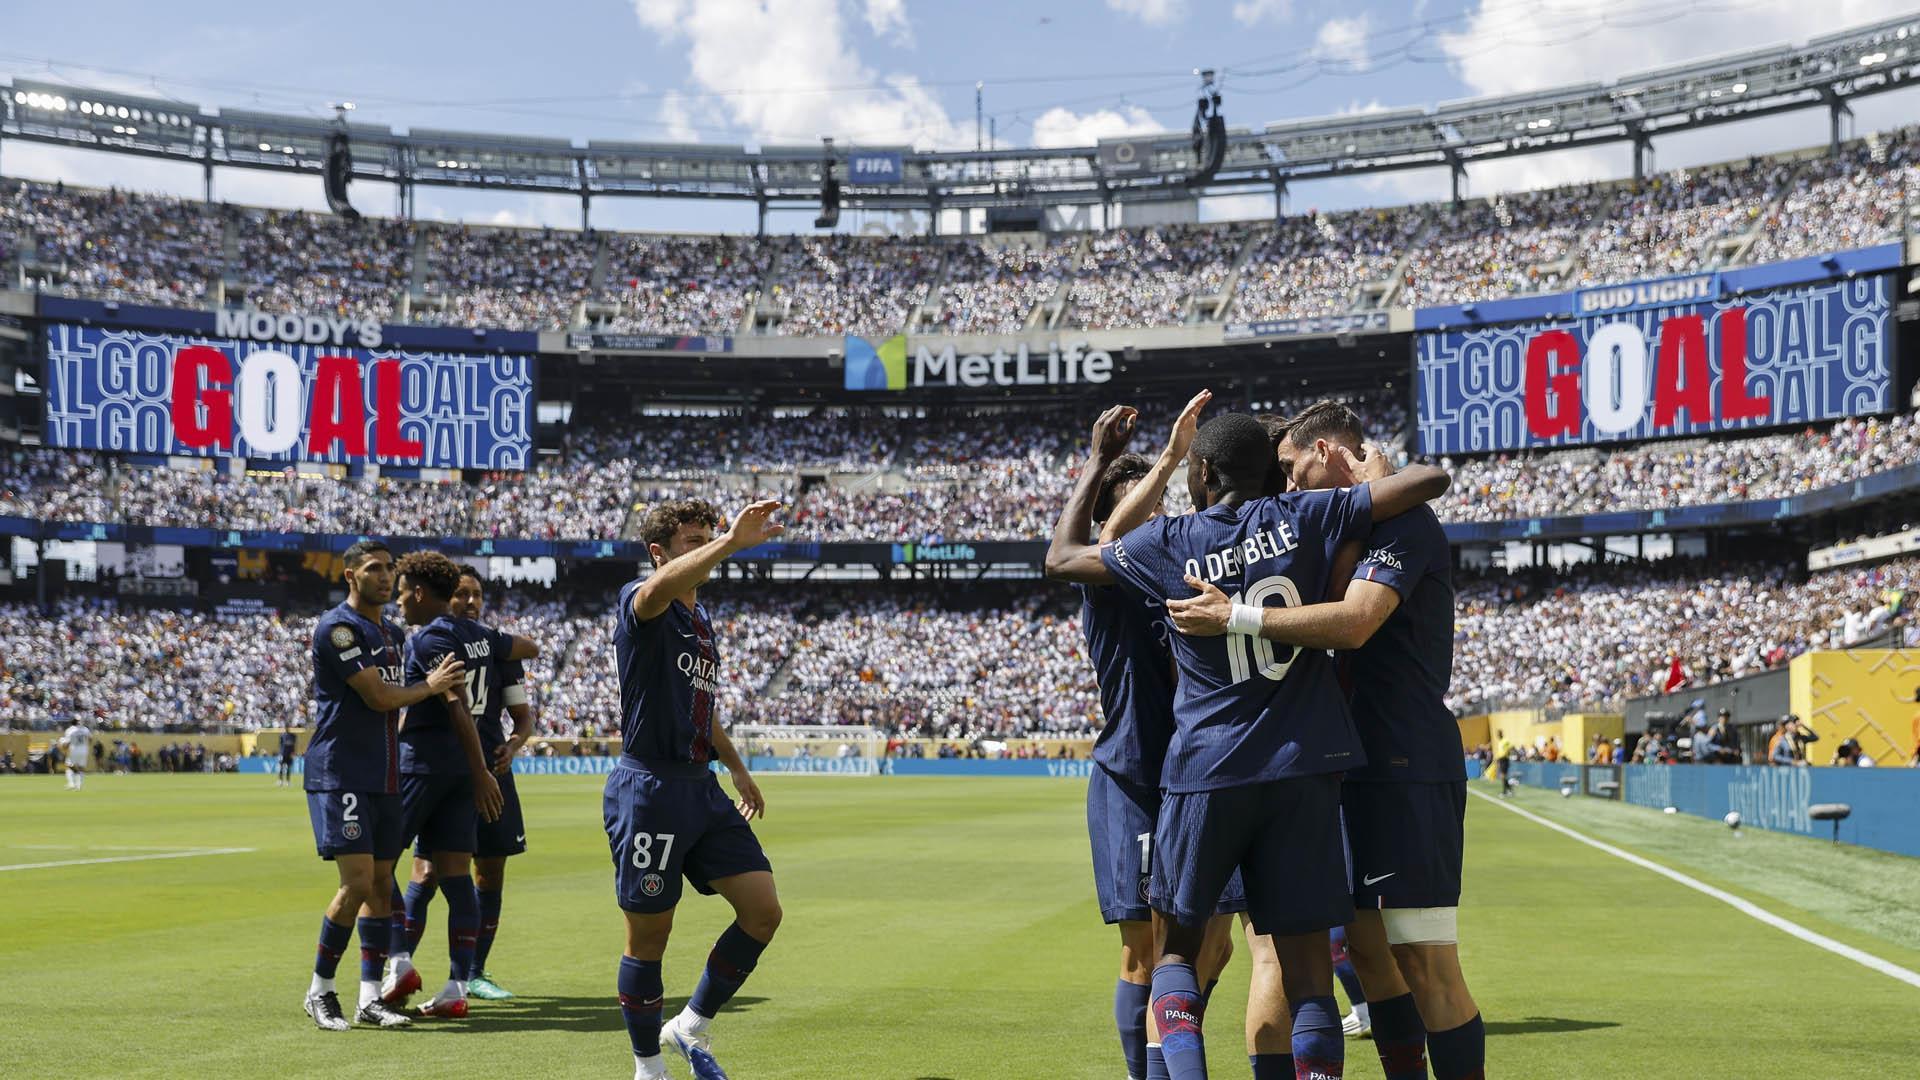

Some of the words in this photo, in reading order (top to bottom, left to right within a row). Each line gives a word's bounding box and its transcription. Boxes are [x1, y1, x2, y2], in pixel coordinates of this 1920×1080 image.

[855, 158, 894, 173] FIFA
[1583, 288, 1634, 312] BUD
[1637, 276, 1712, 305] LIGHT
[216, 310, 383, 348] MOODY'S
[914, 340, 1114, 387] MetLife
[1524, 308, 1771, 438] GOAL
[172, 345, 424, 460] GOAL
[916, 544, 976, 560] MetLife
[1226, 575, 1304, 684] 10
[342, 793, 358, 821] 2
[632, 831, 675, 871] 87
[1165, 1010, 1199, 1024] PARIS
